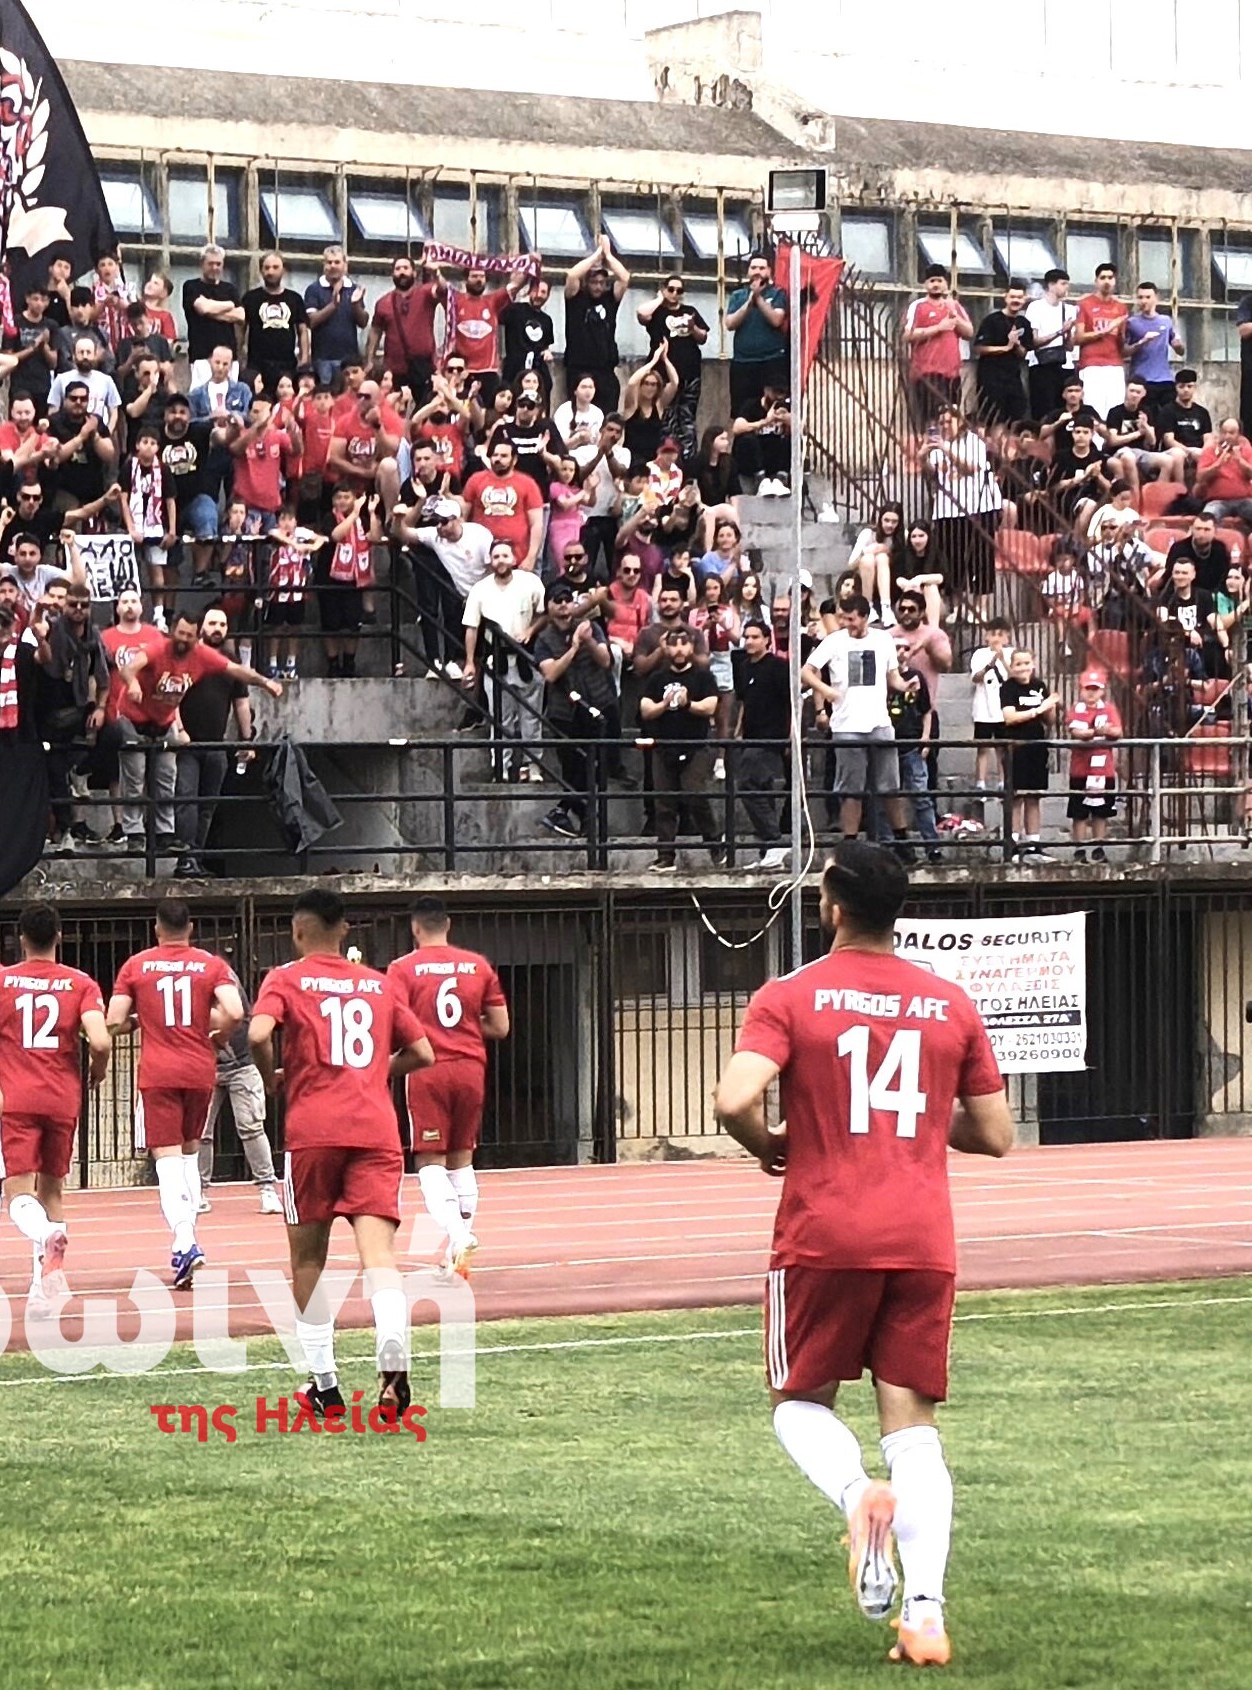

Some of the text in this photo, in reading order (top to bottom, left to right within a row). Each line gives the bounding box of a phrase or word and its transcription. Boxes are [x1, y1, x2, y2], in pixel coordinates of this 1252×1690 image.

[981, 929, 1074, 946] SECURITY
[15, 992, 60, 1049] 12
[156, 975, 192, 1027] 11
[436, 976, 462, 1028] 6
[814, 989, 901, 1018] PYRGOS
[905, 996, 950, 1021] AFC
[1017, 994, 1079, 1010] ΗΛΕΙΑΣ
[319, 996, 375, 1068] 18
[837, 1025, 927, 1138] 14
